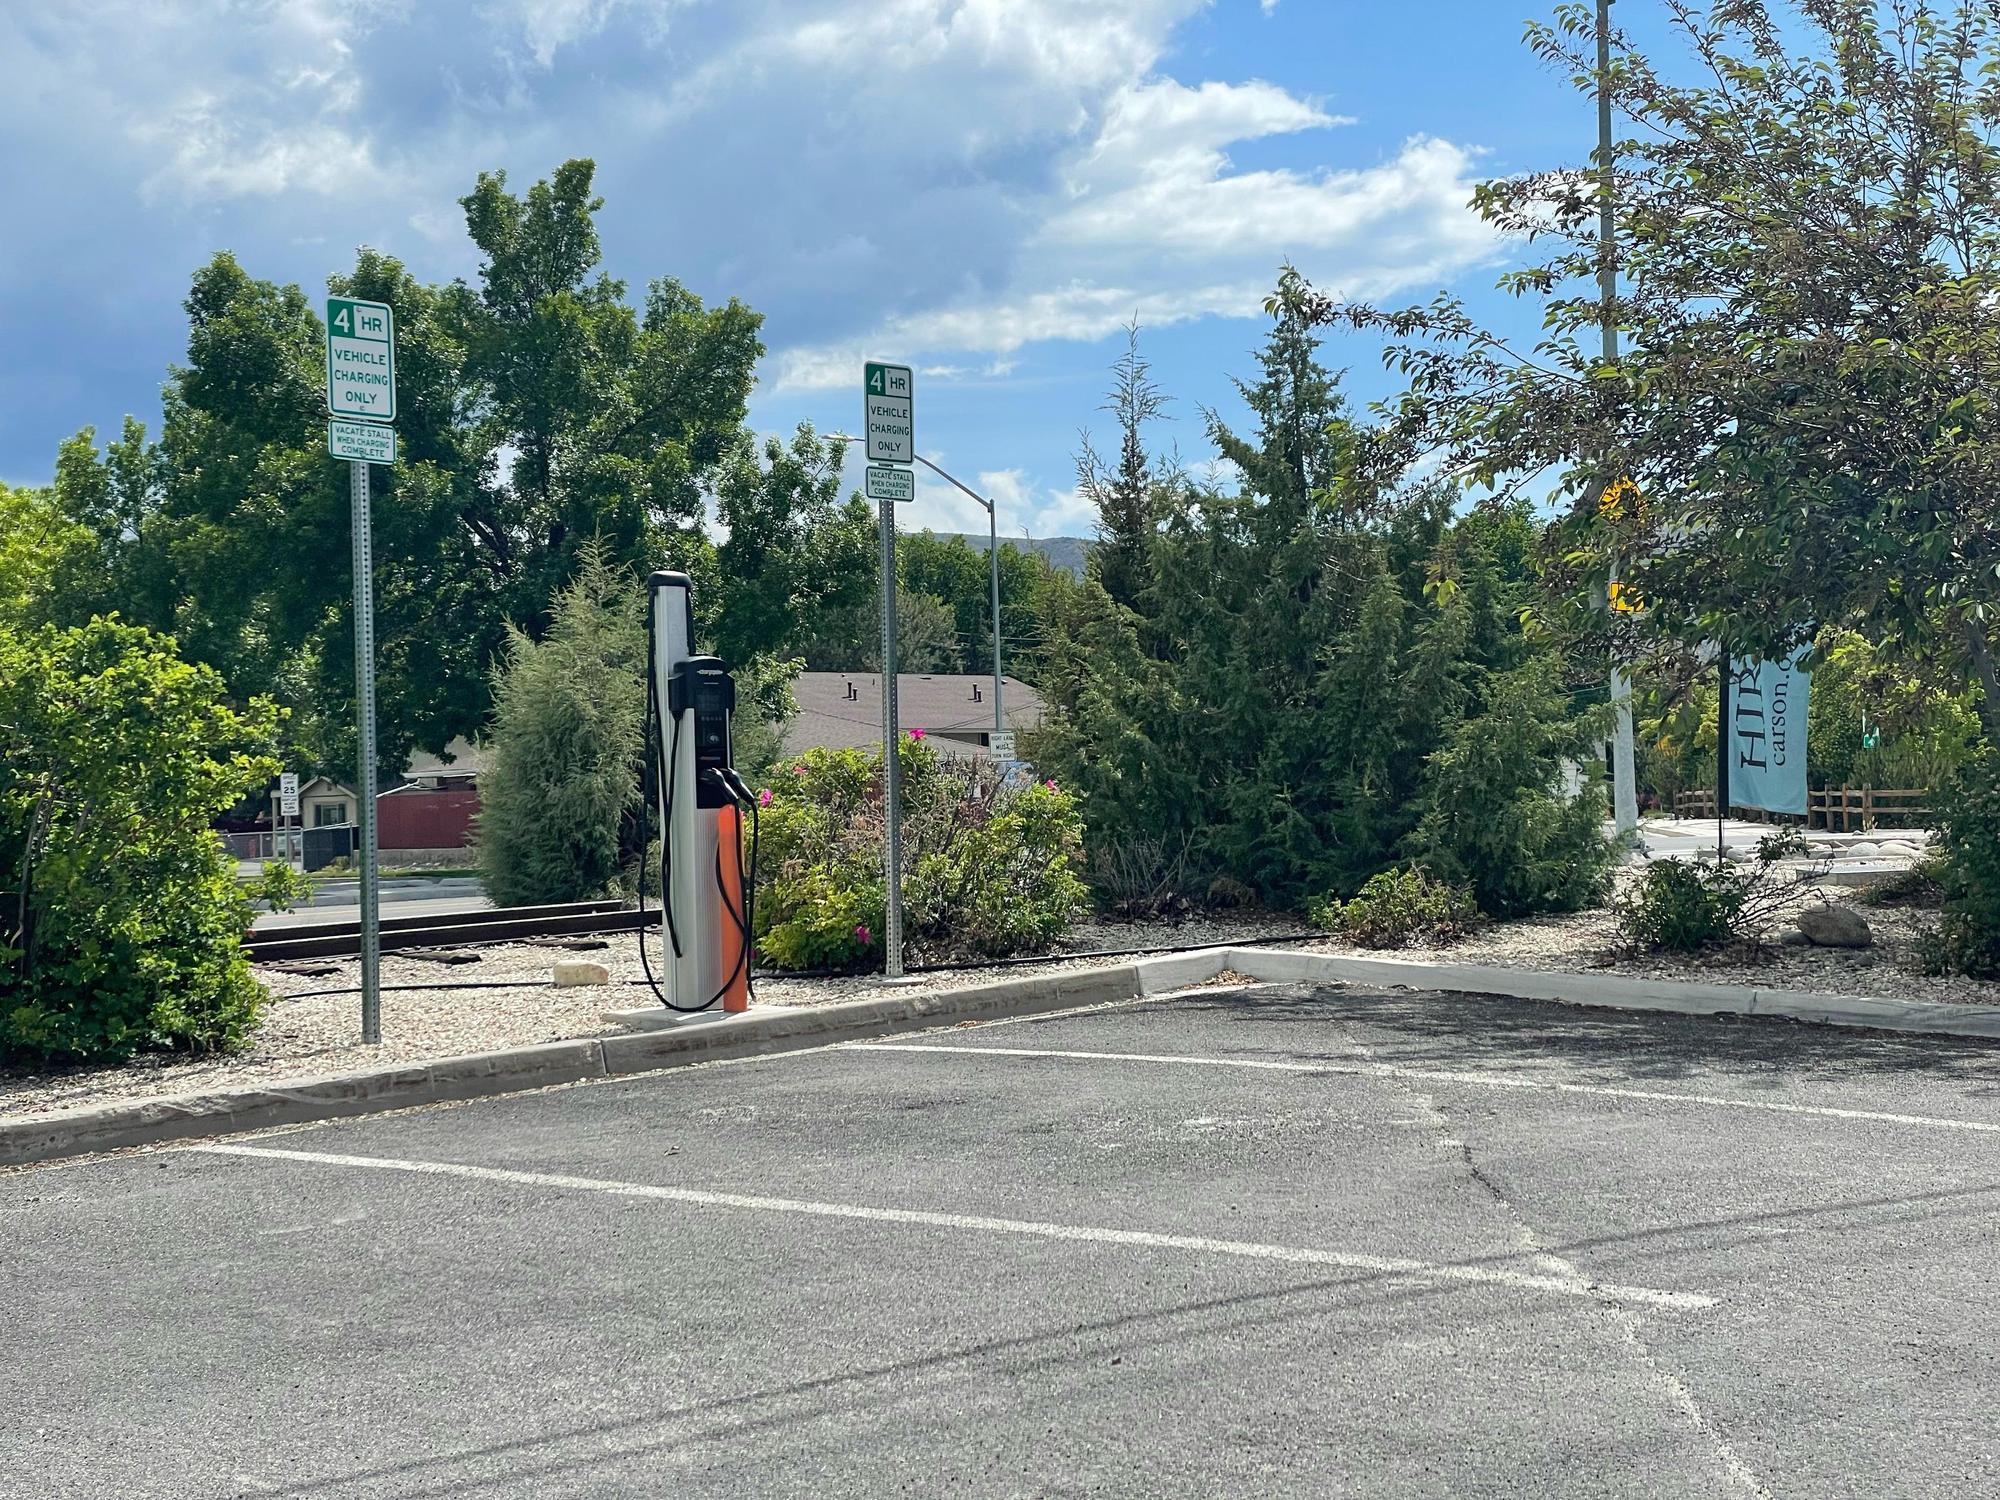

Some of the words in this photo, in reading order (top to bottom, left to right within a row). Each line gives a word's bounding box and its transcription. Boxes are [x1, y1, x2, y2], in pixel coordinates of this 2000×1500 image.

[333, 308, 350, 333] 4
[361, 316, 382, 332] HR
[334, 349, 386, 366] VEHICLE
[334, 369, 388, 386] CHARGING
[870, 370, 882, 392] 4
[890, 376, 905, 391] HR
[345, 391, 377, 404] ONLY
[870, 405, 908, 419] VEHICLE
[335, 425, 365, 436] VACATE
[367, 430, 391, 439] STALL
[870, 423, 909, 436] CHARGING
[337, 436, 355, 444] WHEN
[357, 438, 390, 449] CHARGING
[878, 441, 901, 453] ONLY
[341, 445, 385, 458] COMPLETE
[870, 471, 891, 480] VACATE
[893, 473, 911, 482] STALL
[874, 487, 906, 497] COMPLETE
[1736, 658, 1767, 773] HIR
[1772, 657, 1793, 767] carson.o
[283, 786, 296, 794] 25
